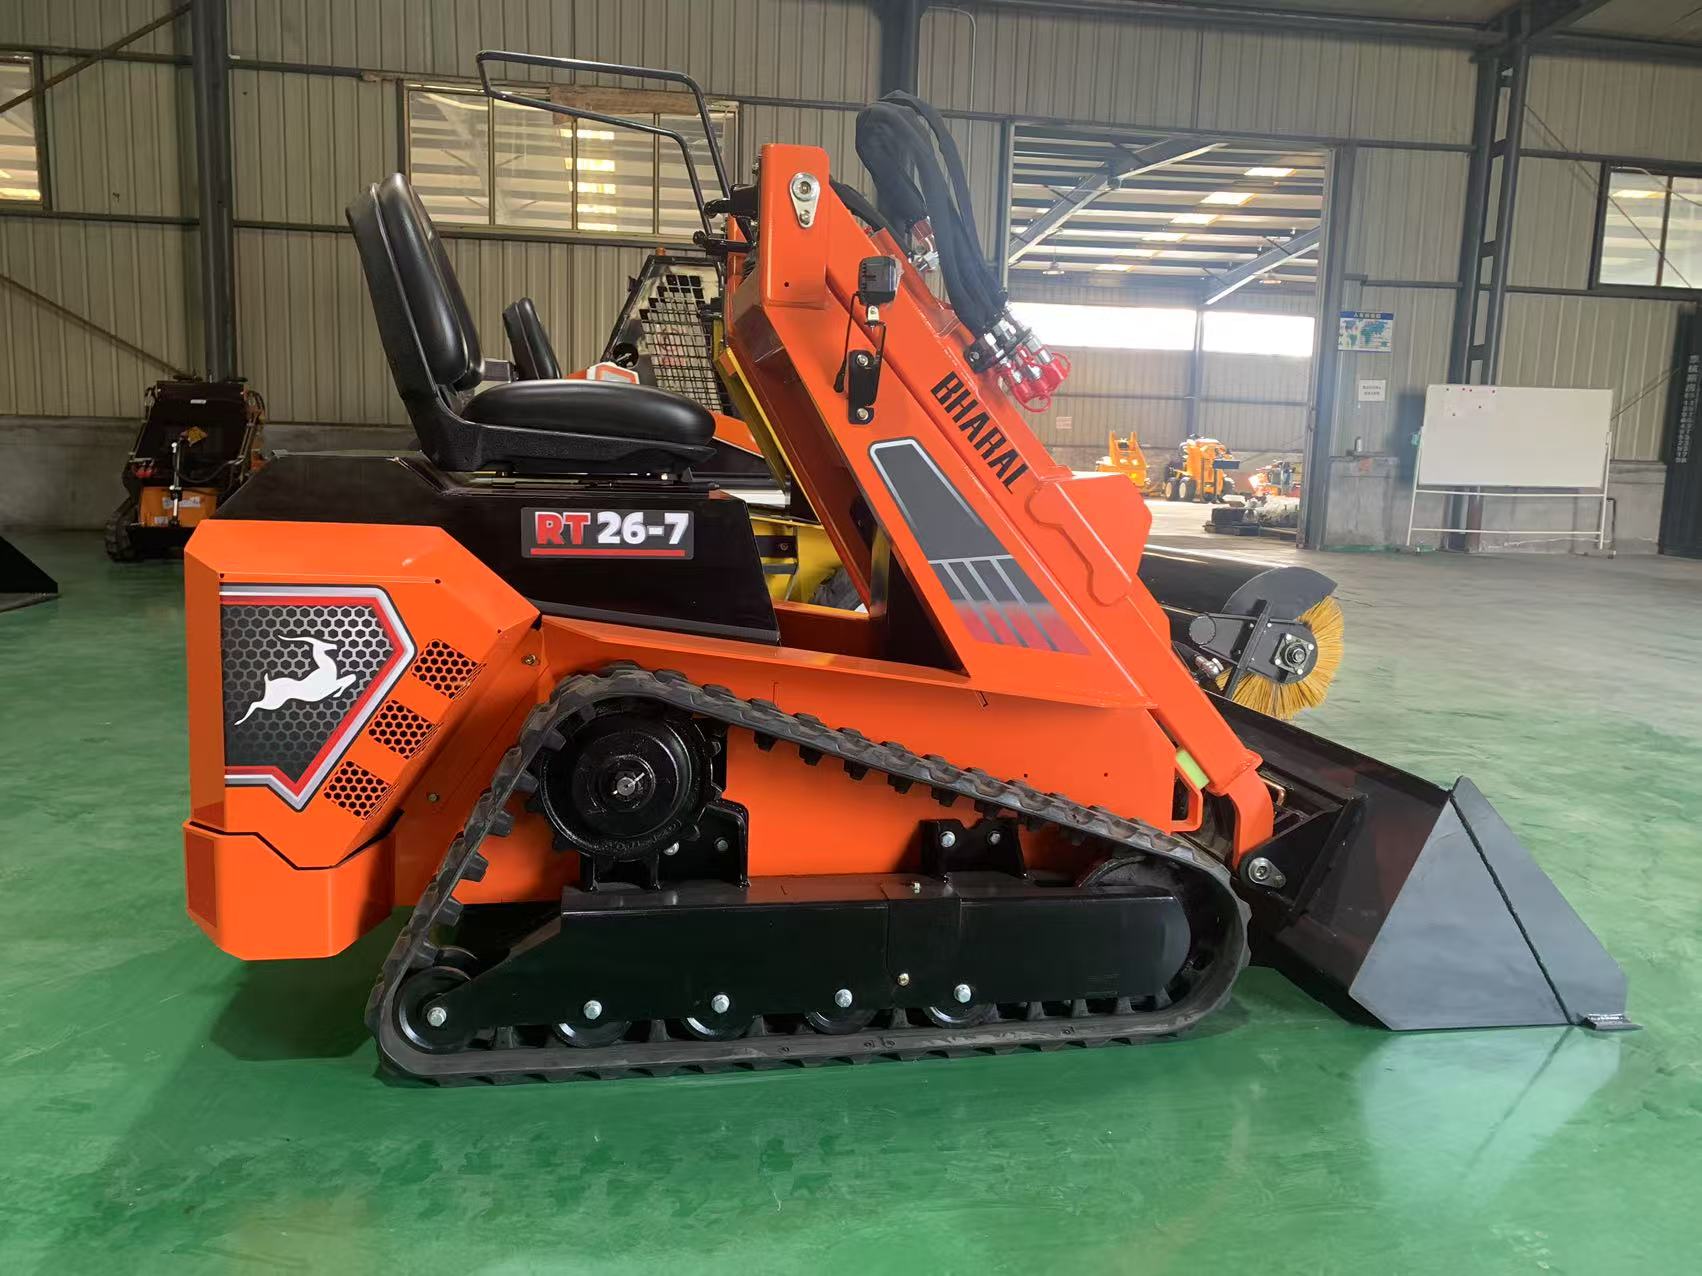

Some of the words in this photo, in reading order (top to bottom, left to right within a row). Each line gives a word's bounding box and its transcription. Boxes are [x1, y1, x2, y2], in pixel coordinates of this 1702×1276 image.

[930, 371, 1029, 494] BHARAL
[535, 512, 591, 544] RT
[597, 511, 689, 544] 26-7
